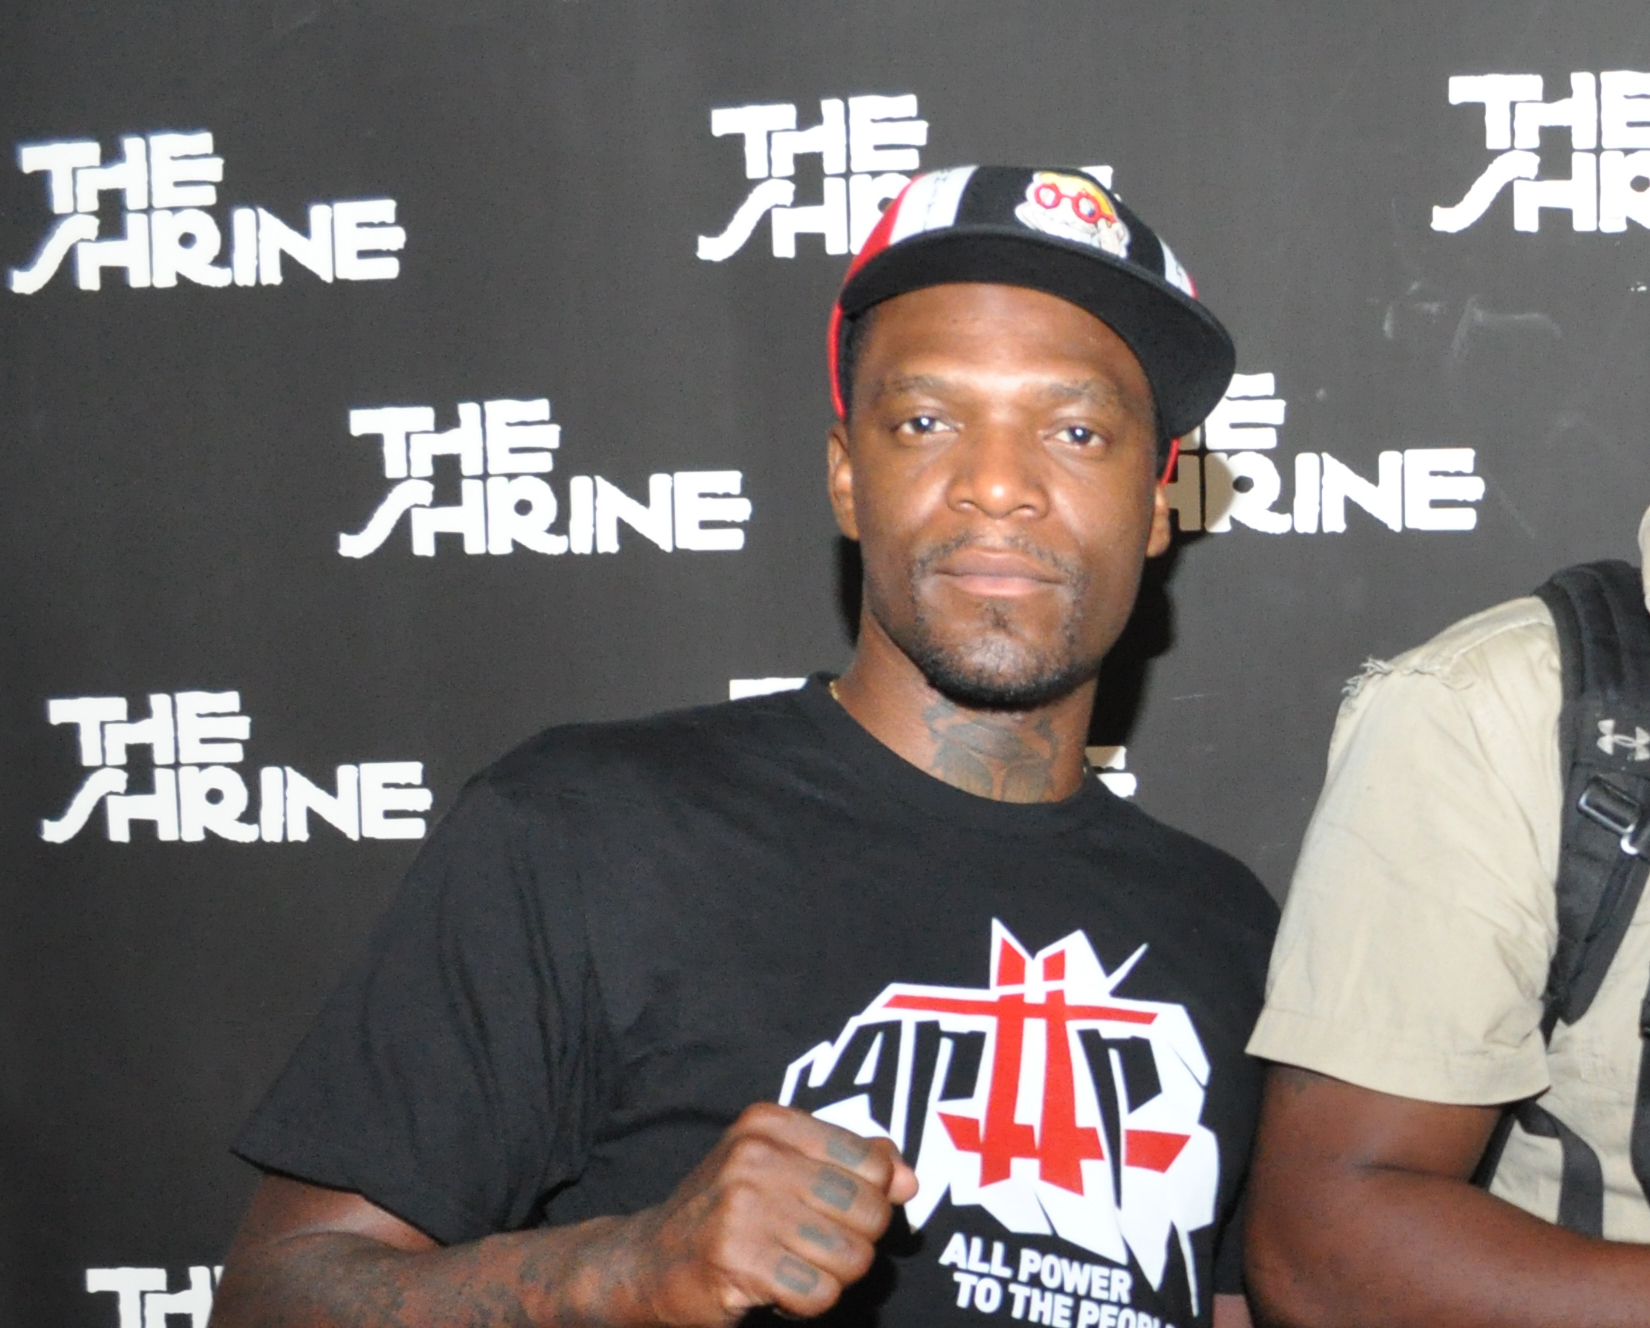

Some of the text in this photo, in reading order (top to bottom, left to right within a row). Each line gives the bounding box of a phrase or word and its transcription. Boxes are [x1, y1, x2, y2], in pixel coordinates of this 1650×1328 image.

[19, 130, 225, 214] THE
[710, 93, 930, 180] THE
[9, 198, 407, 295] SHRINE
[348, 397, 562, 479] THE
[337, 470, 753, 559] SHRINE
[47, 690, 252, 767] THE
[41, 762, 434, 844] SHRINE
[938, 1232, 1132, 1304] ALL POWER
[953, 1271, 1003, 1314] TO
